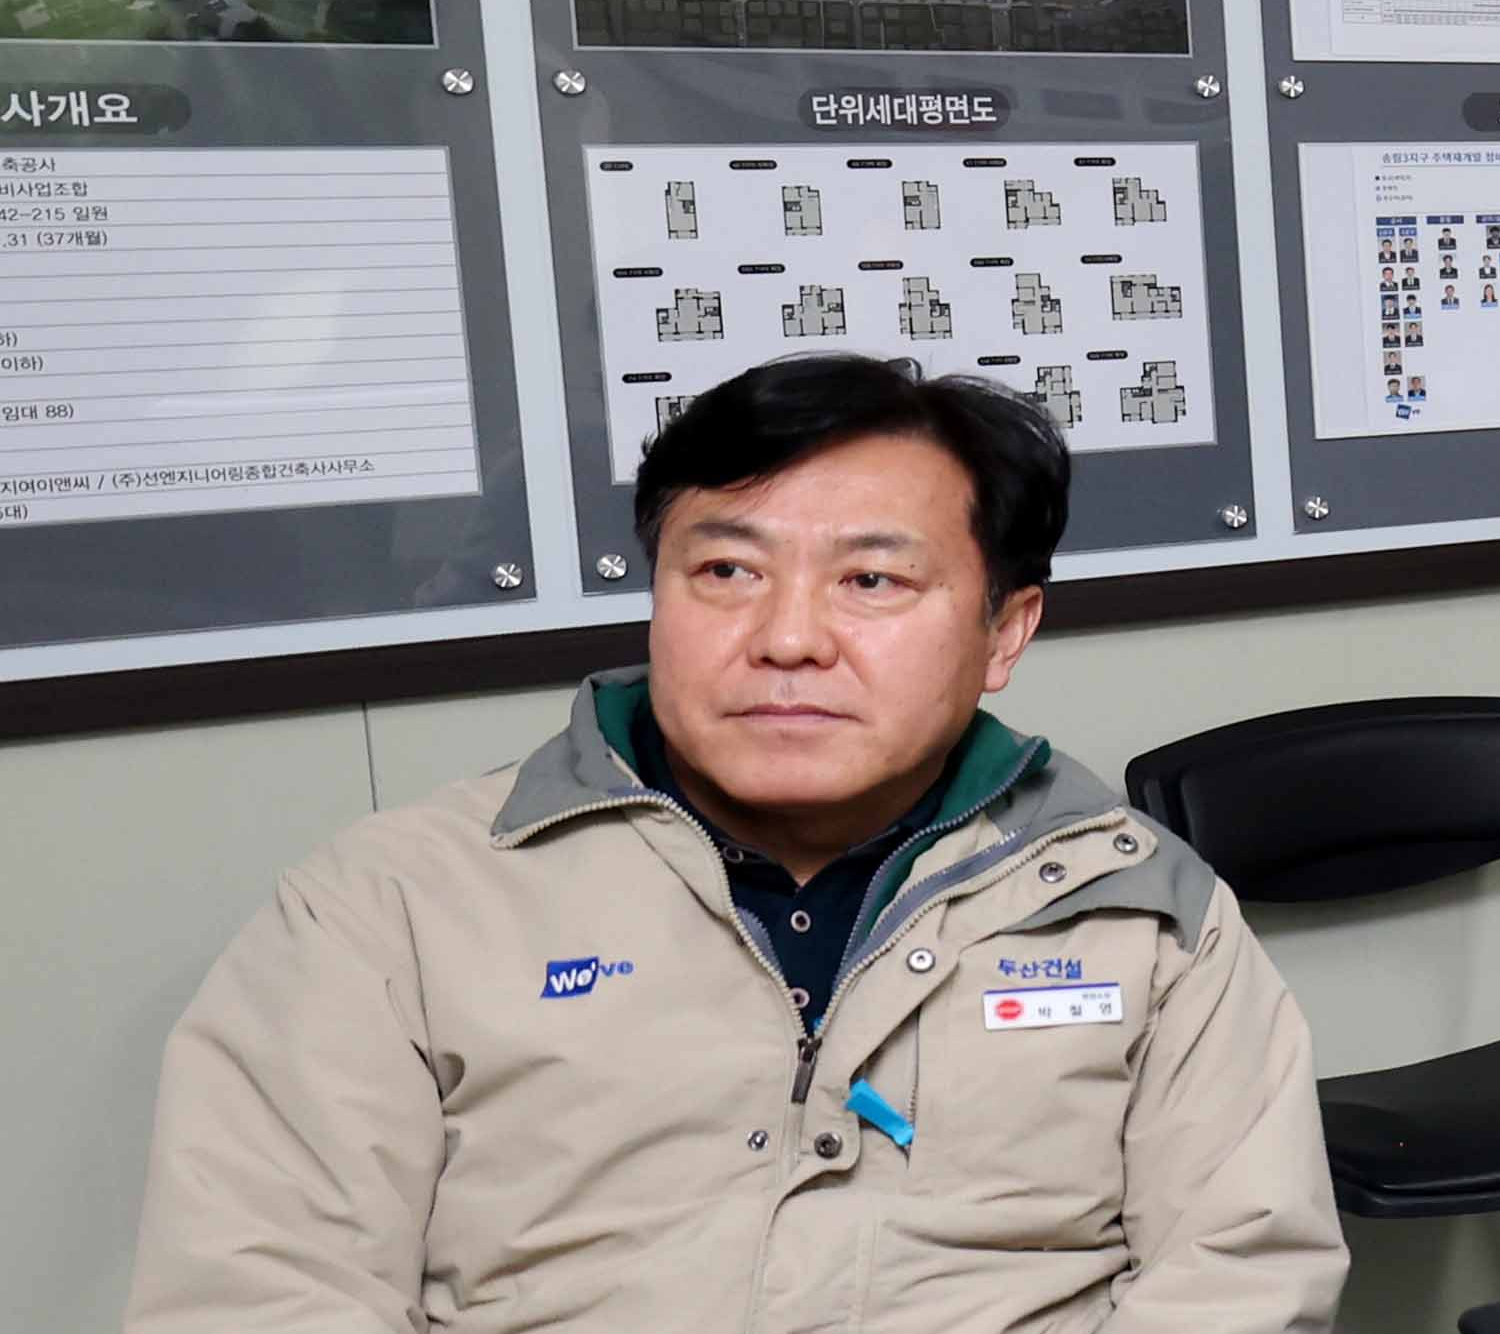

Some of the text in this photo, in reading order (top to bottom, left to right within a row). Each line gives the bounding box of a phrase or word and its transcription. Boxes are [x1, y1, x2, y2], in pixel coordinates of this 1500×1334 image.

[812, 94, 997, 125] 단위세대평면도
[73, 205, 109, 221] 일원
[36, 230, 108, 248] (37개월)
[2, 402, 75, 422] 임대 88)
[998, 958, 1082, 980] 두산건설
